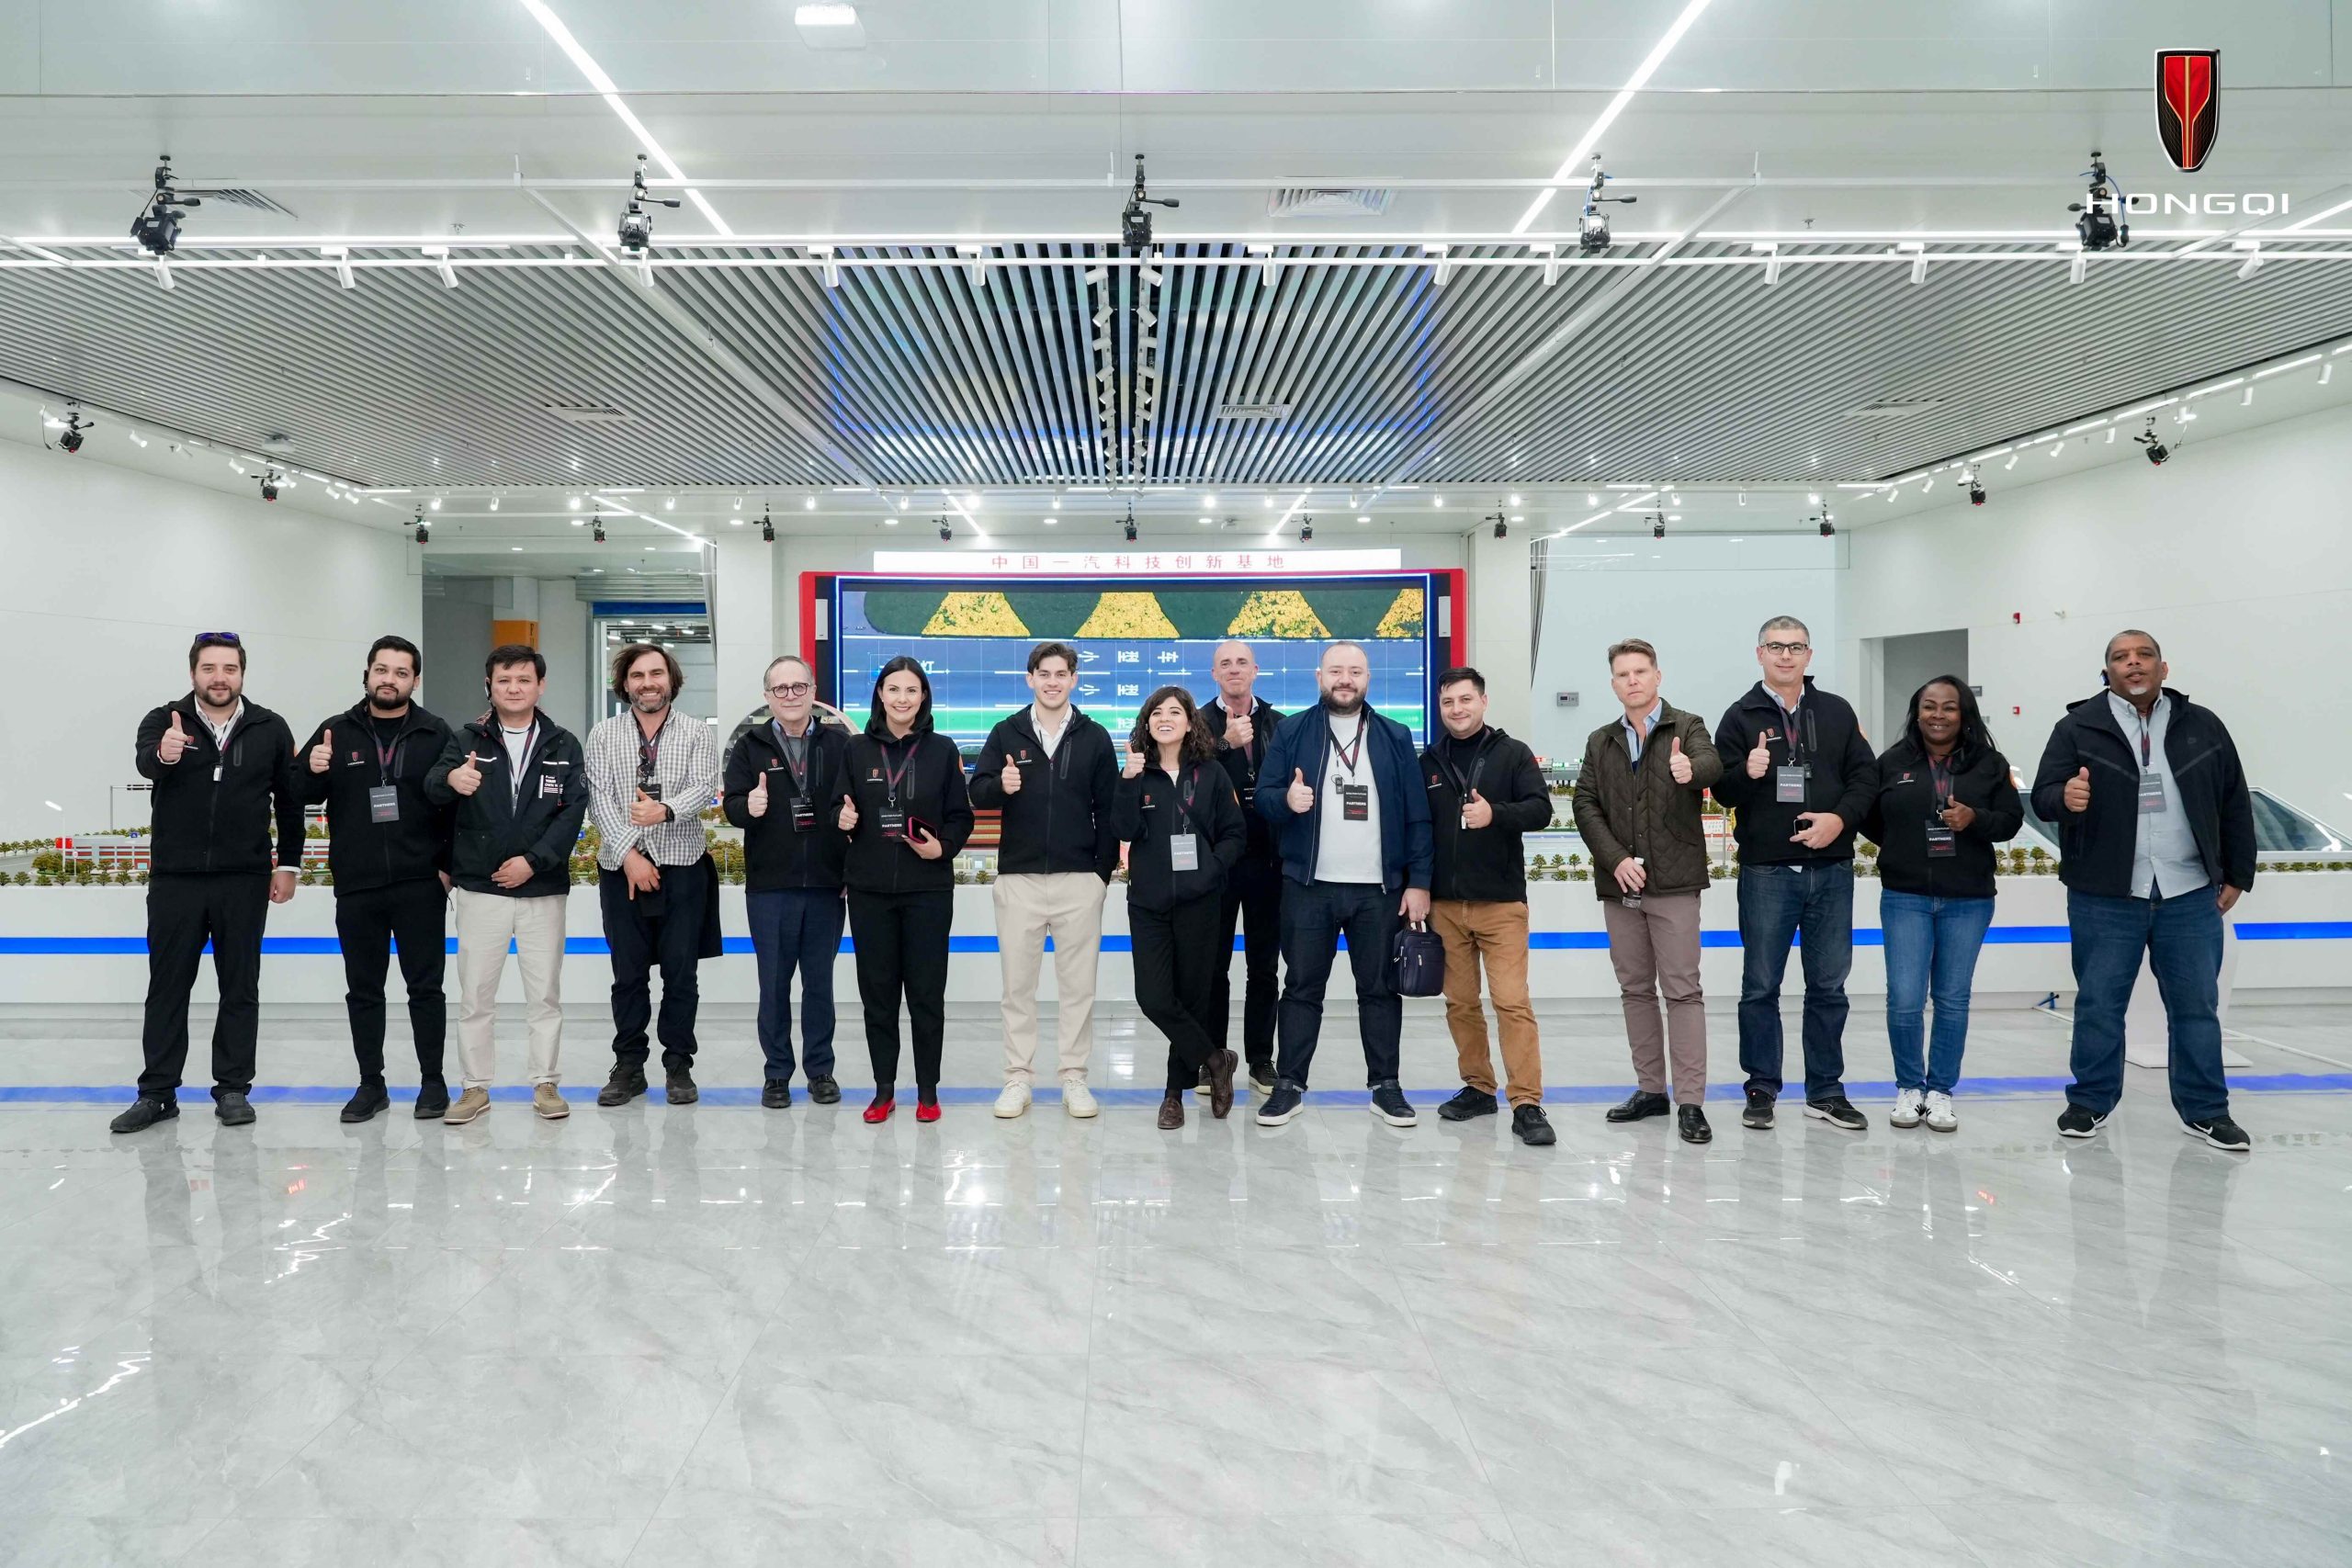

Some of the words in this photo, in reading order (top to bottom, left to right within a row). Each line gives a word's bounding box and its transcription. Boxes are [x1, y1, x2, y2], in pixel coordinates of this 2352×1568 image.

[991, 554, 1285, 570] 中国一汽科技创新基地
